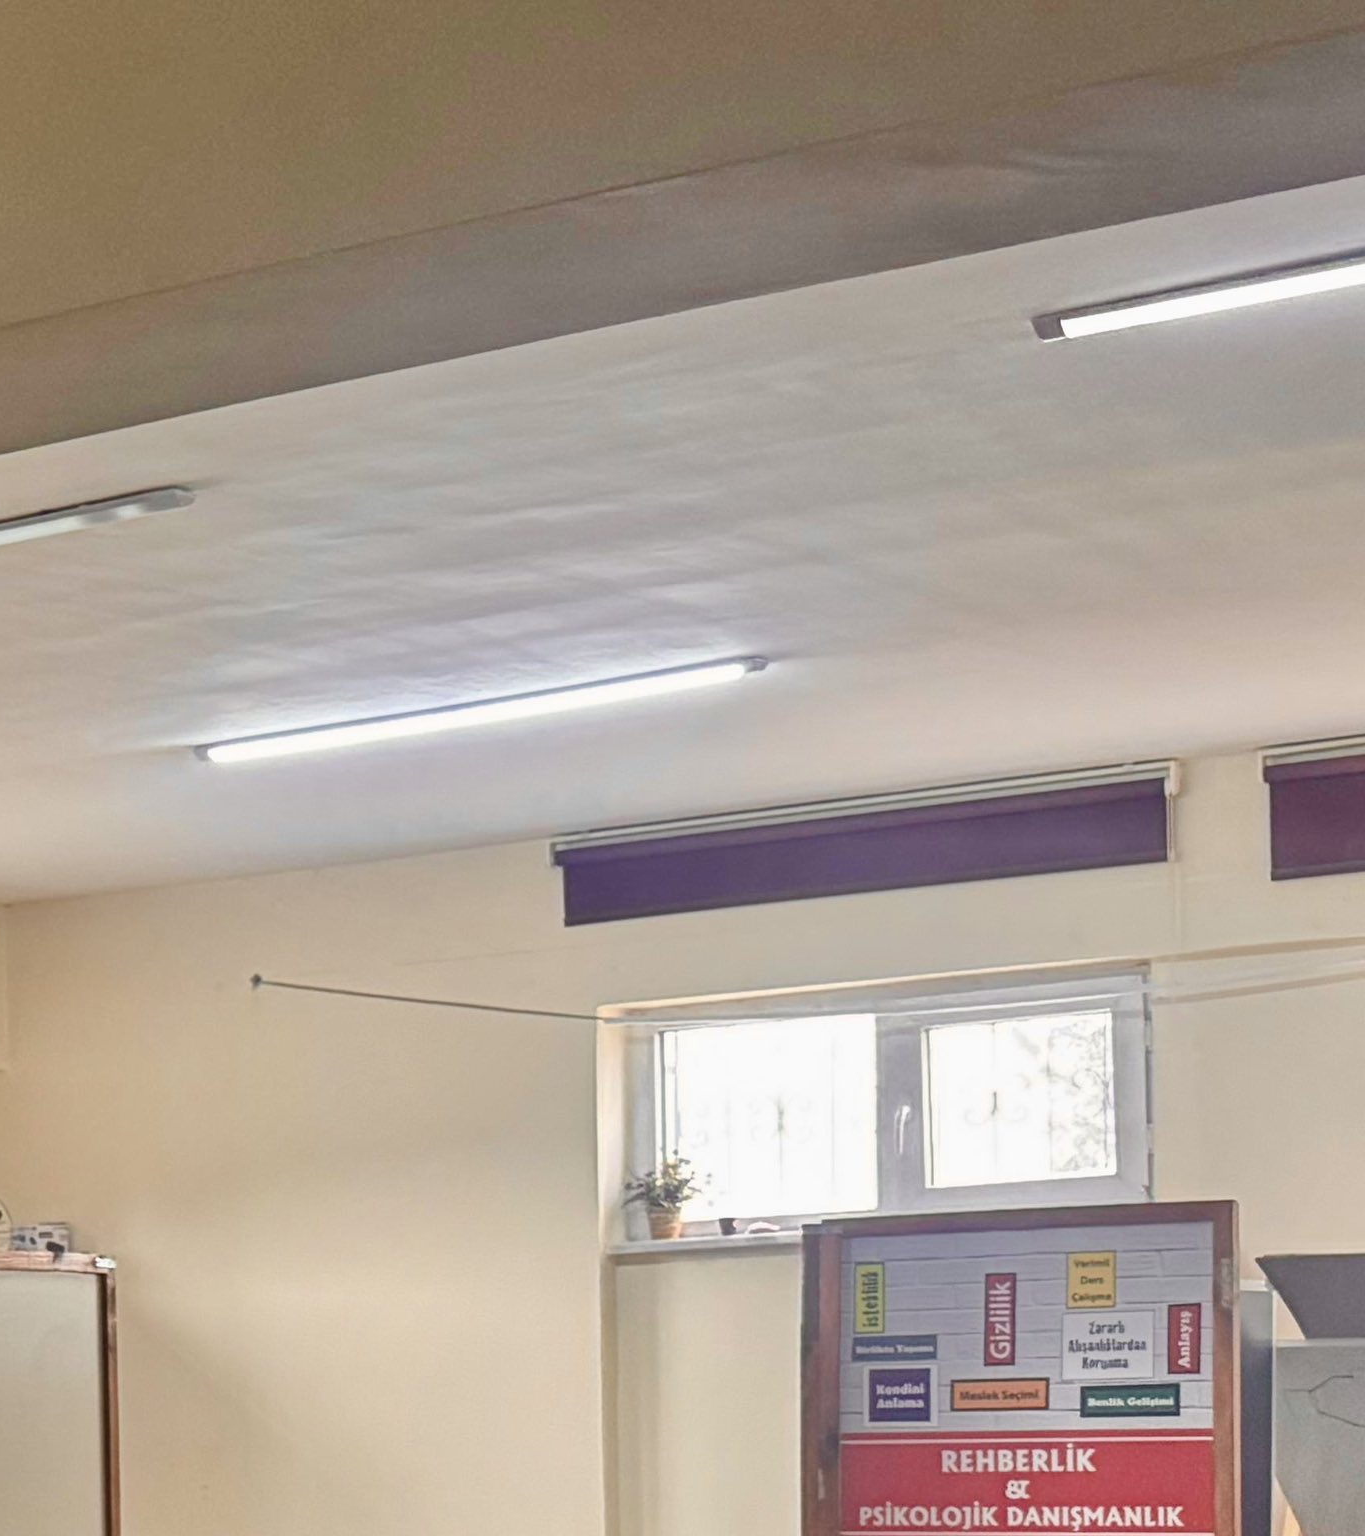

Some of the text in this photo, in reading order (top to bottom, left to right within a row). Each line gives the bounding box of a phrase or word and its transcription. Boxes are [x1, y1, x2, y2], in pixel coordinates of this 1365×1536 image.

[1080, 1276, 1104, 1285] Ders
[989, 1281, 1011, 1360] Gizlilik
[1178, 1311, 1193, 1368] Anlayış
[1082, 1357, 1129, 1370] Korunma
[876, 1382, 925, 1395] Kendini
[876, 1397, 925, 1409] Anlama
[1087, 1396, 1175, 1408] Benlik Gelişimi
[941, 1442, 1097, 1473] REHBERLİK
[1005, 1479, 1030, 1500] &
[859, 1500, 1185, 1531] PSİKOLOJİK DANIŞMANLIK
